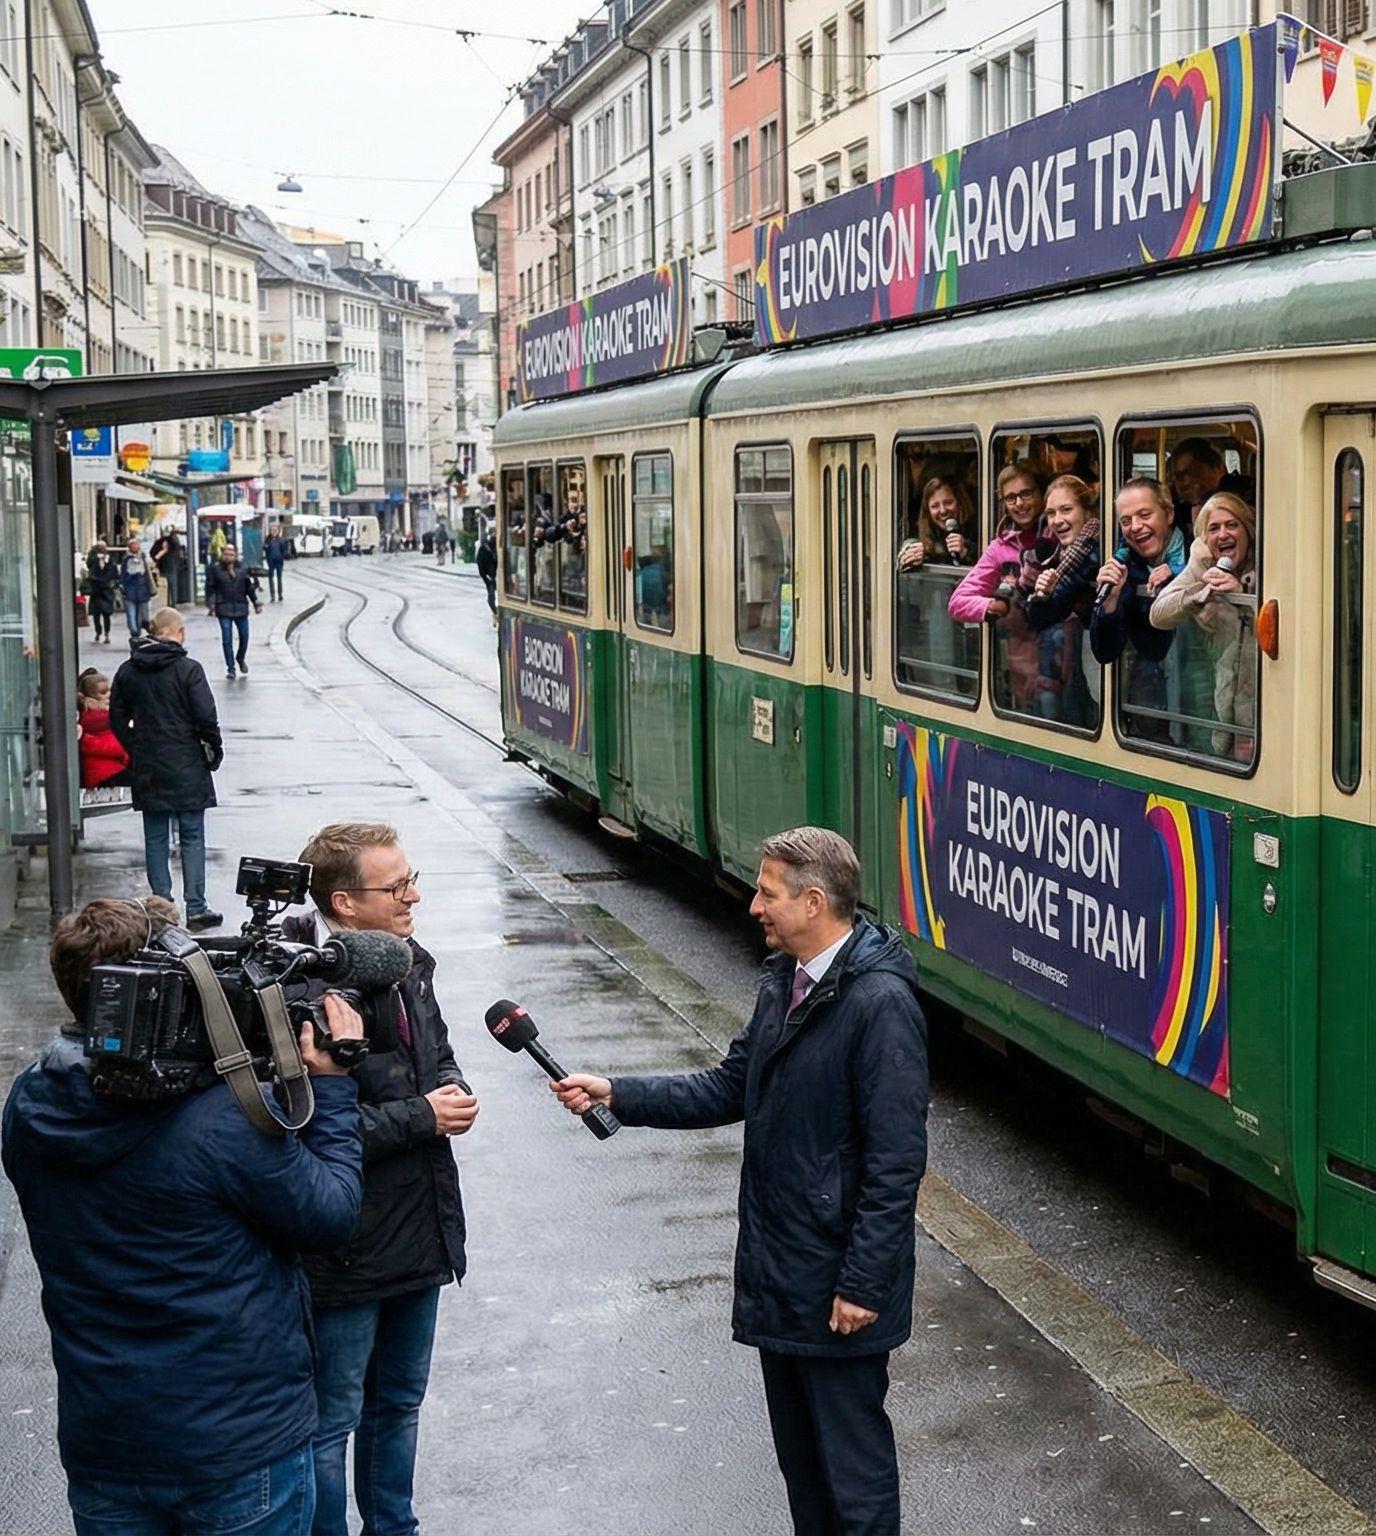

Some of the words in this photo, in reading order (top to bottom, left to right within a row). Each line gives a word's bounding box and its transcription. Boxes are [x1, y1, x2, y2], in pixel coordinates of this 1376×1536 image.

[779, 203, 916, 311] EUROVISION
[924, 147, 1077, 275] KARAOKE
[1087, 100, 1212, 231] TRAM
[525, 323, 580, 381] EUROVISION
[580, 303, 634, 366] KARAOKE
[635, 285, 673, 350] TRAM
[967, 780, 1120, 889] EUROVISION
[949, 840, 1060, 941] KARAOKE
[1067, 887, 1146, 980] TRAM
